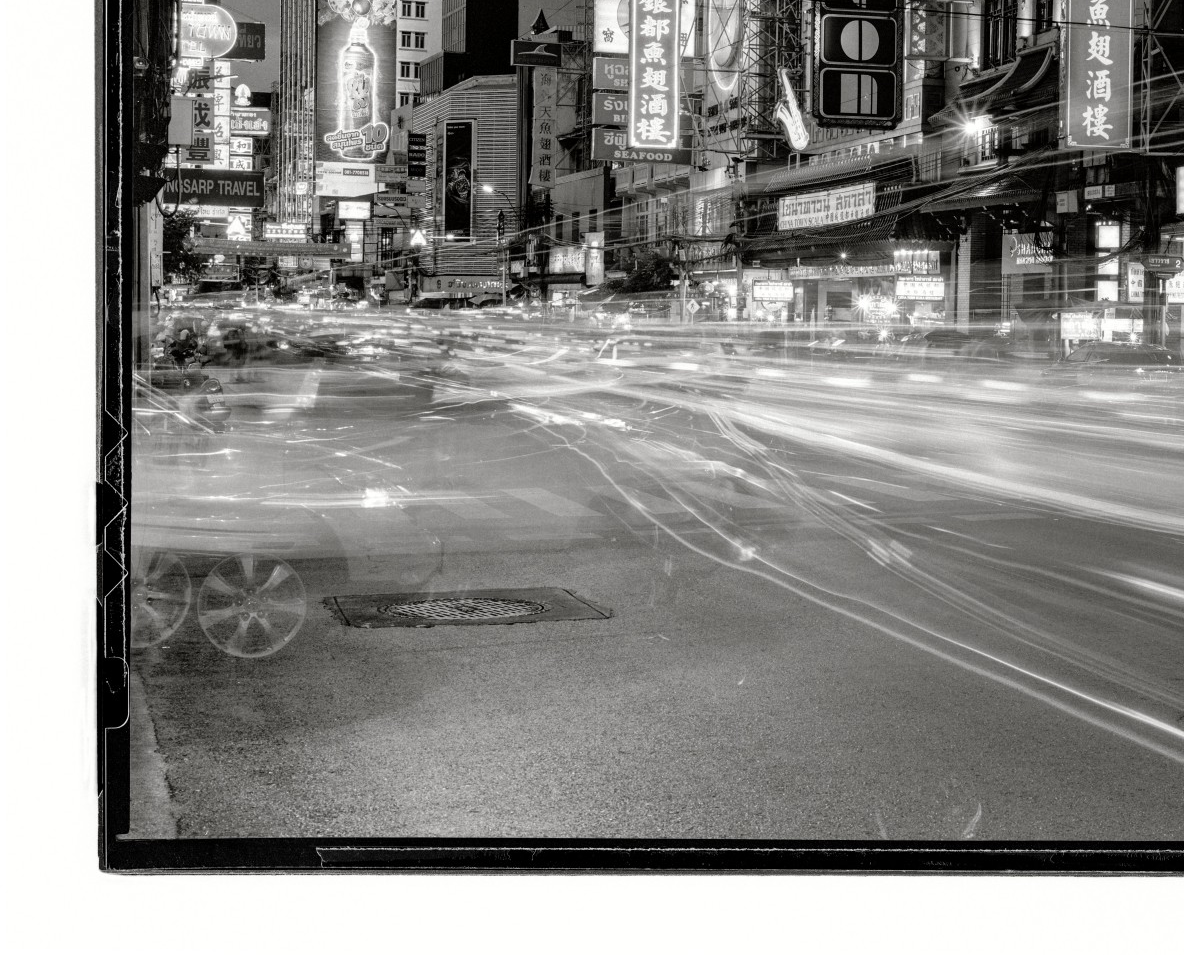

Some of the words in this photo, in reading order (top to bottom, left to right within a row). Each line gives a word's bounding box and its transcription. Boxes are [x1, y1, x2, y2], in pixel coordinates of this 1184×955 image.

[361, 122, 388, 144] 10
[613, 150, 673, 162] SEAFOOD
[217, 180, 261, 196] TRAVEL
[1175, 259, 1182, 268] 2
